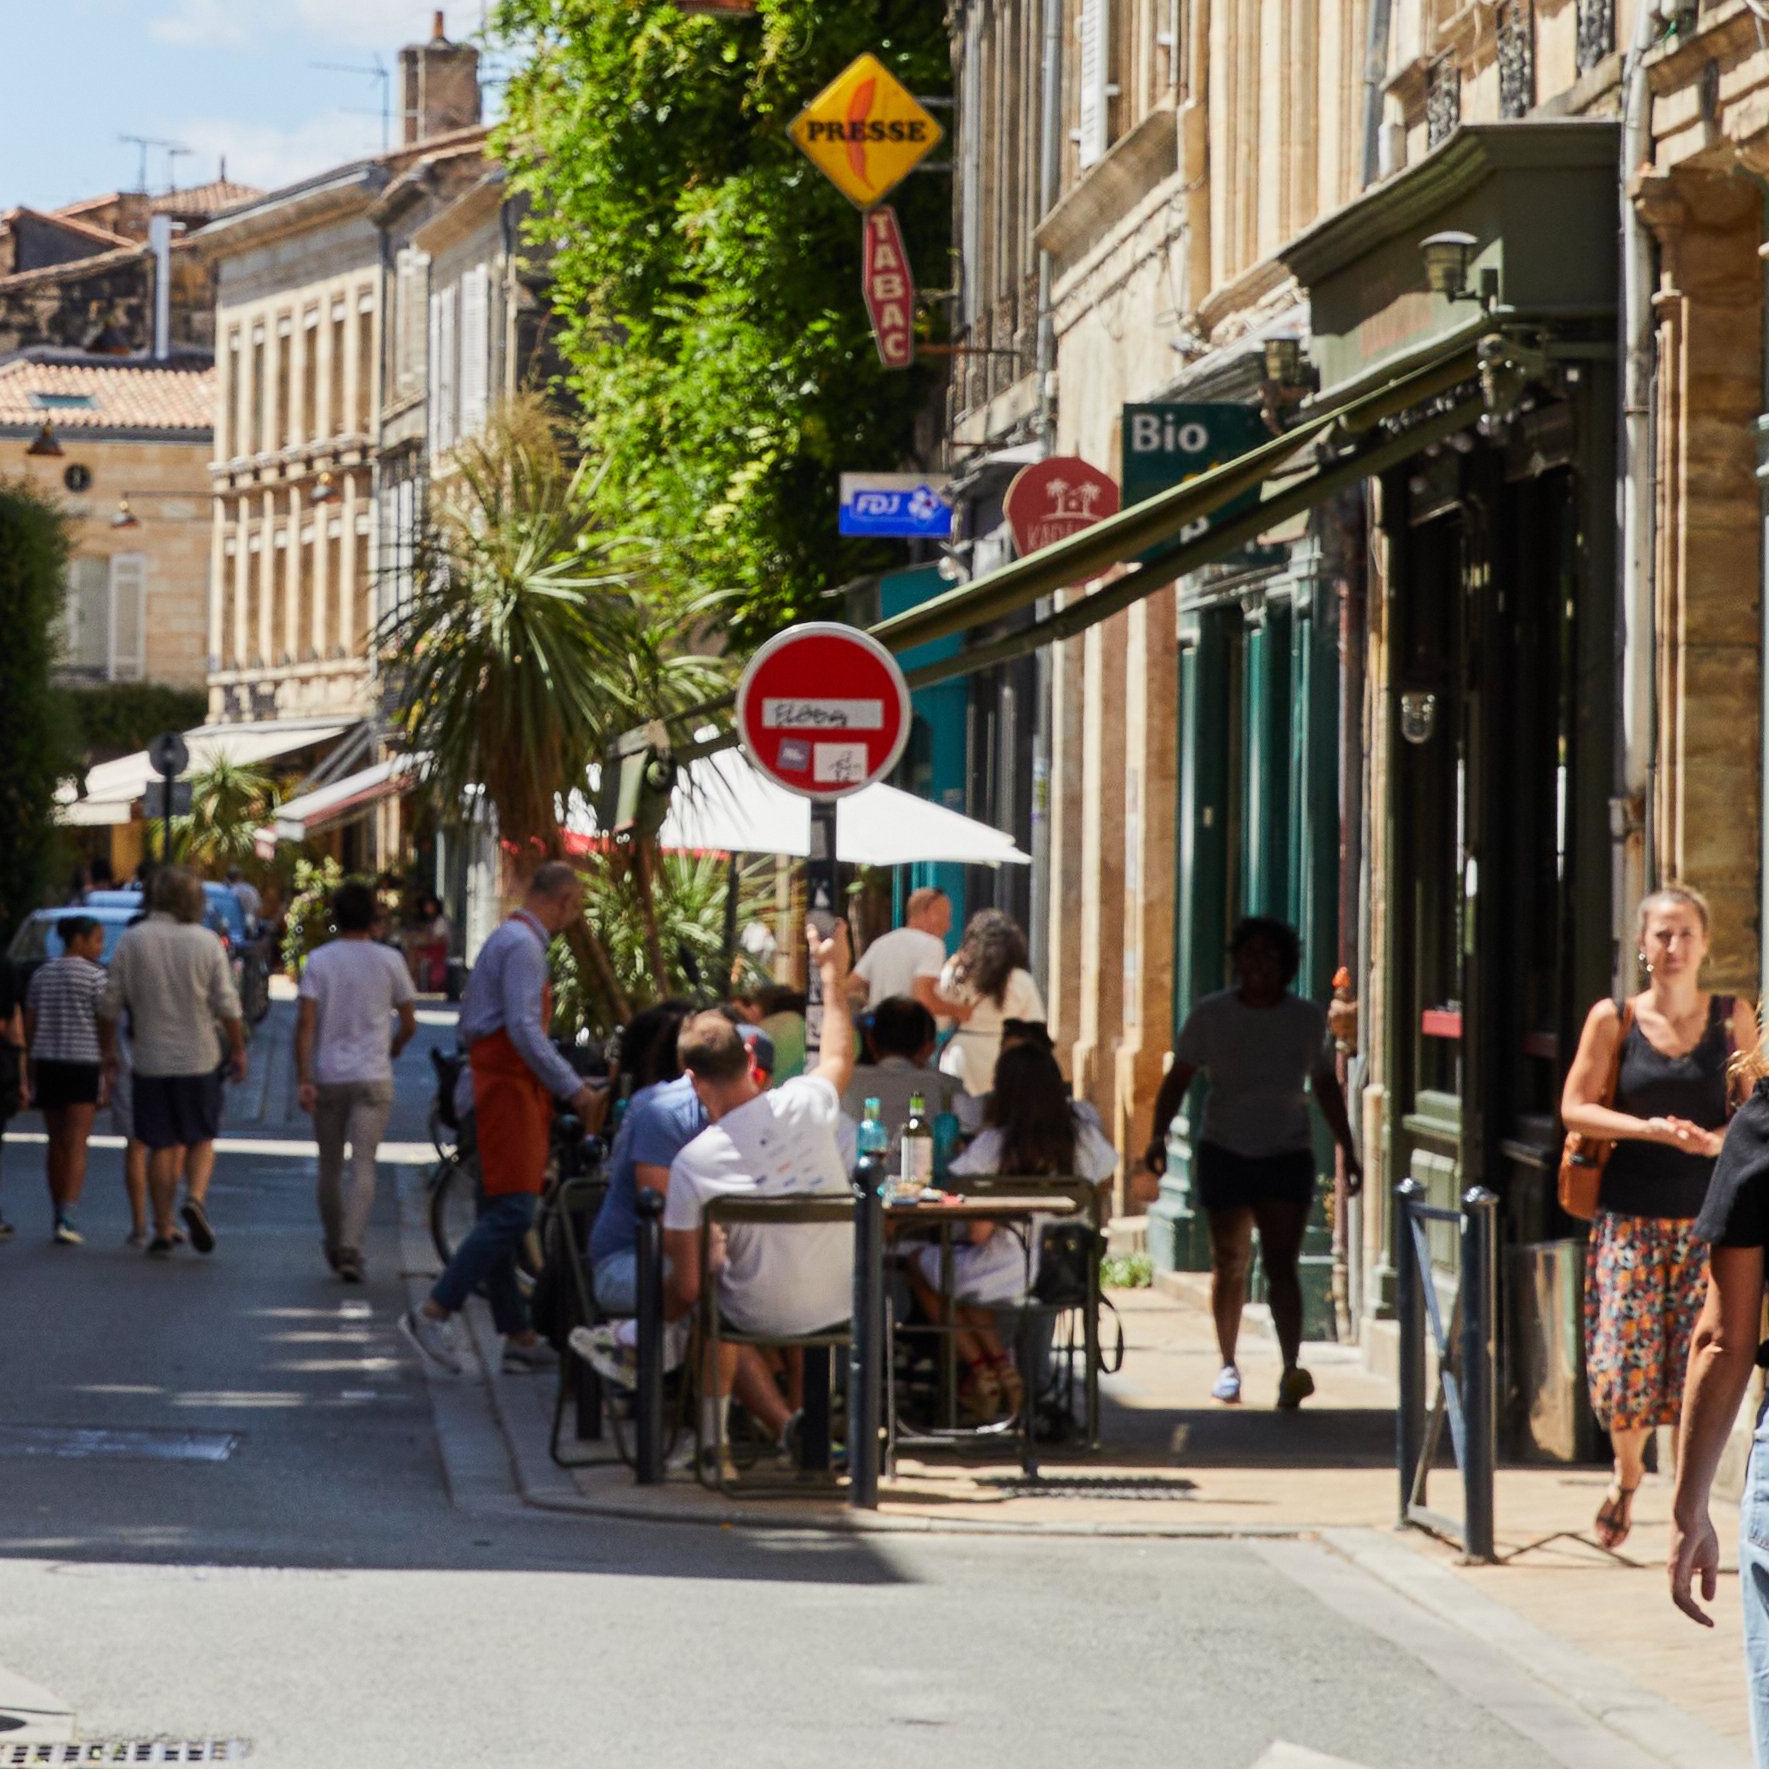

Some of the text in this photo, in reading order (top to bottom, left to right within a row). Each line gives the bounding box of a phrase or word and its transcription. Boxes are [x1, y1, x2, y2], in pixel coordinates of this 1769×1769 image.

[806, 120, 927, 143] PRESSE
[870, 213, 906, 359] TABAC
[1132, 412, 1209, 454] Bio
[856, 494, 900, 515] FDJ
